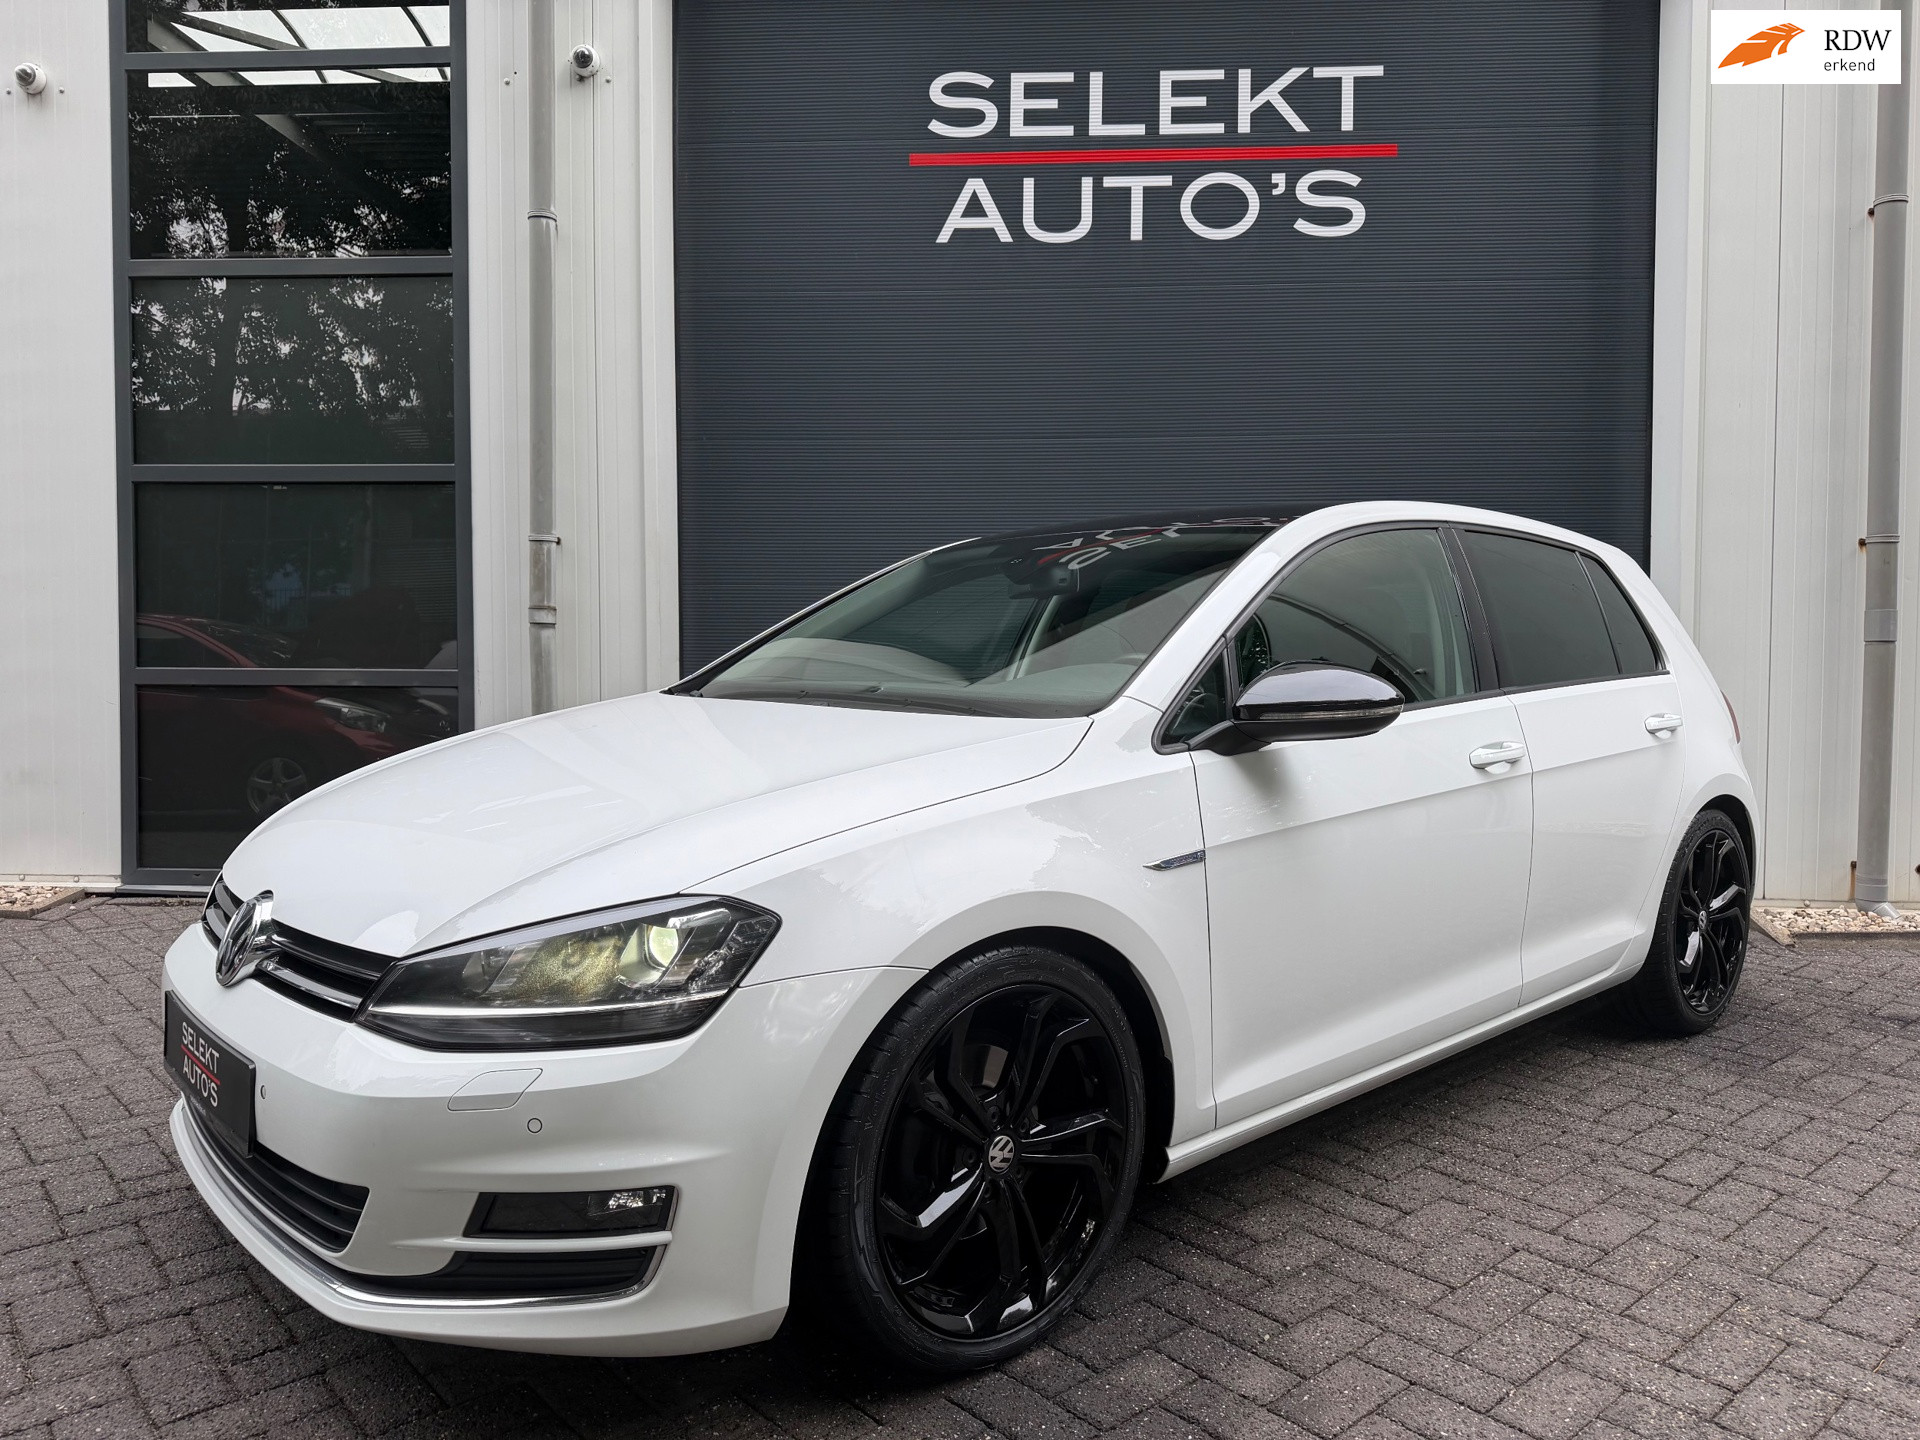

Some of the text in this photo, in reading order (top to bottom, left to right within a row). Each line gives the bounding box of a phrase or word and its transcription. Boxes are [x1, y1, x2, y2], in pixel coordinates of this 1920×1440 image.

[927, 65, 1384, 138] SELEKT
[935, 169, 1366, 244] AUTO'S
[182, 1021, 220, 1074] SELEKT
[182, 1054, 218, 1107] AUTO'S
